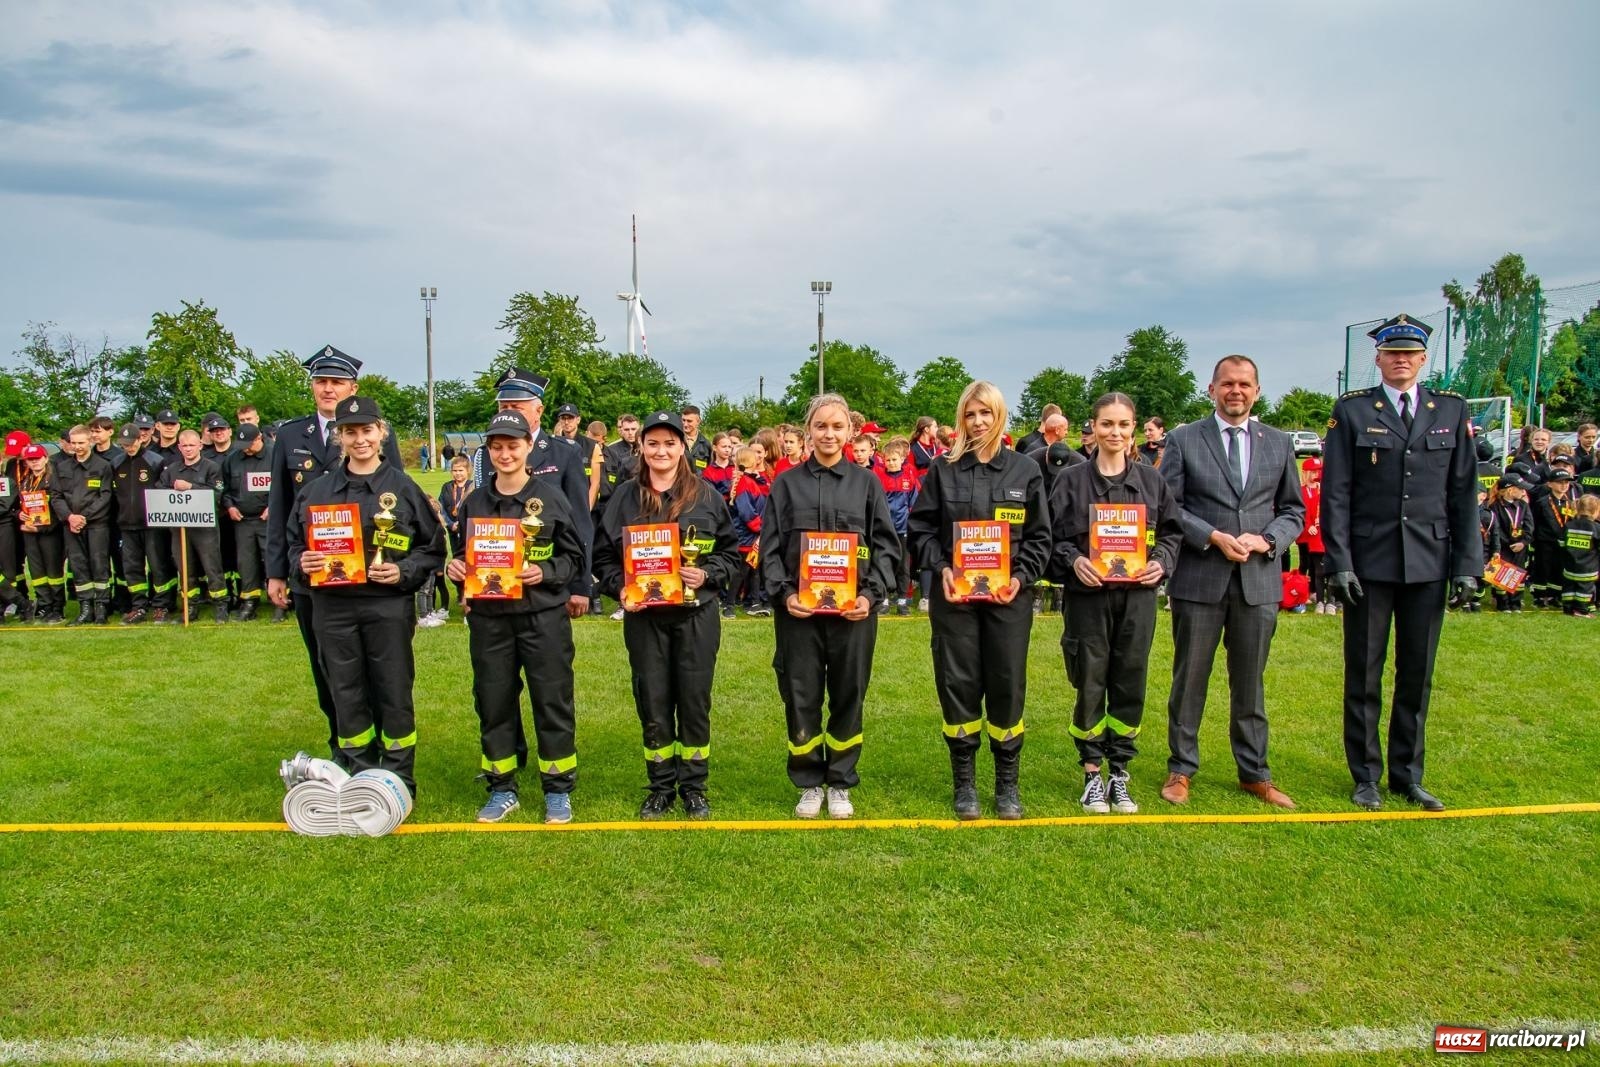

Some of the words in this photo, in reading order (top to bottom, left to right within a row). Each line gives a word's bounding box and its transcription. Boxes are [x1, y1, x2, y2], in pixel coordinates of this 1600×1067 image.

[252, 476, 271, 487] OSP
[169, 493, 192, 505] OSP
[148, 512, 214, 524] KRZANOWICE
[312, 510, 352, 525] DYPLOM
[1097, 509, 1138, 523] DYPLOM
[474, 524, 516, 537] DYPLOM
[630, 529, 671, 544] DYPLOM
[961, 525, 1002, 539] DYPLOM
[808, 538, 850, 552] DYPLOM
